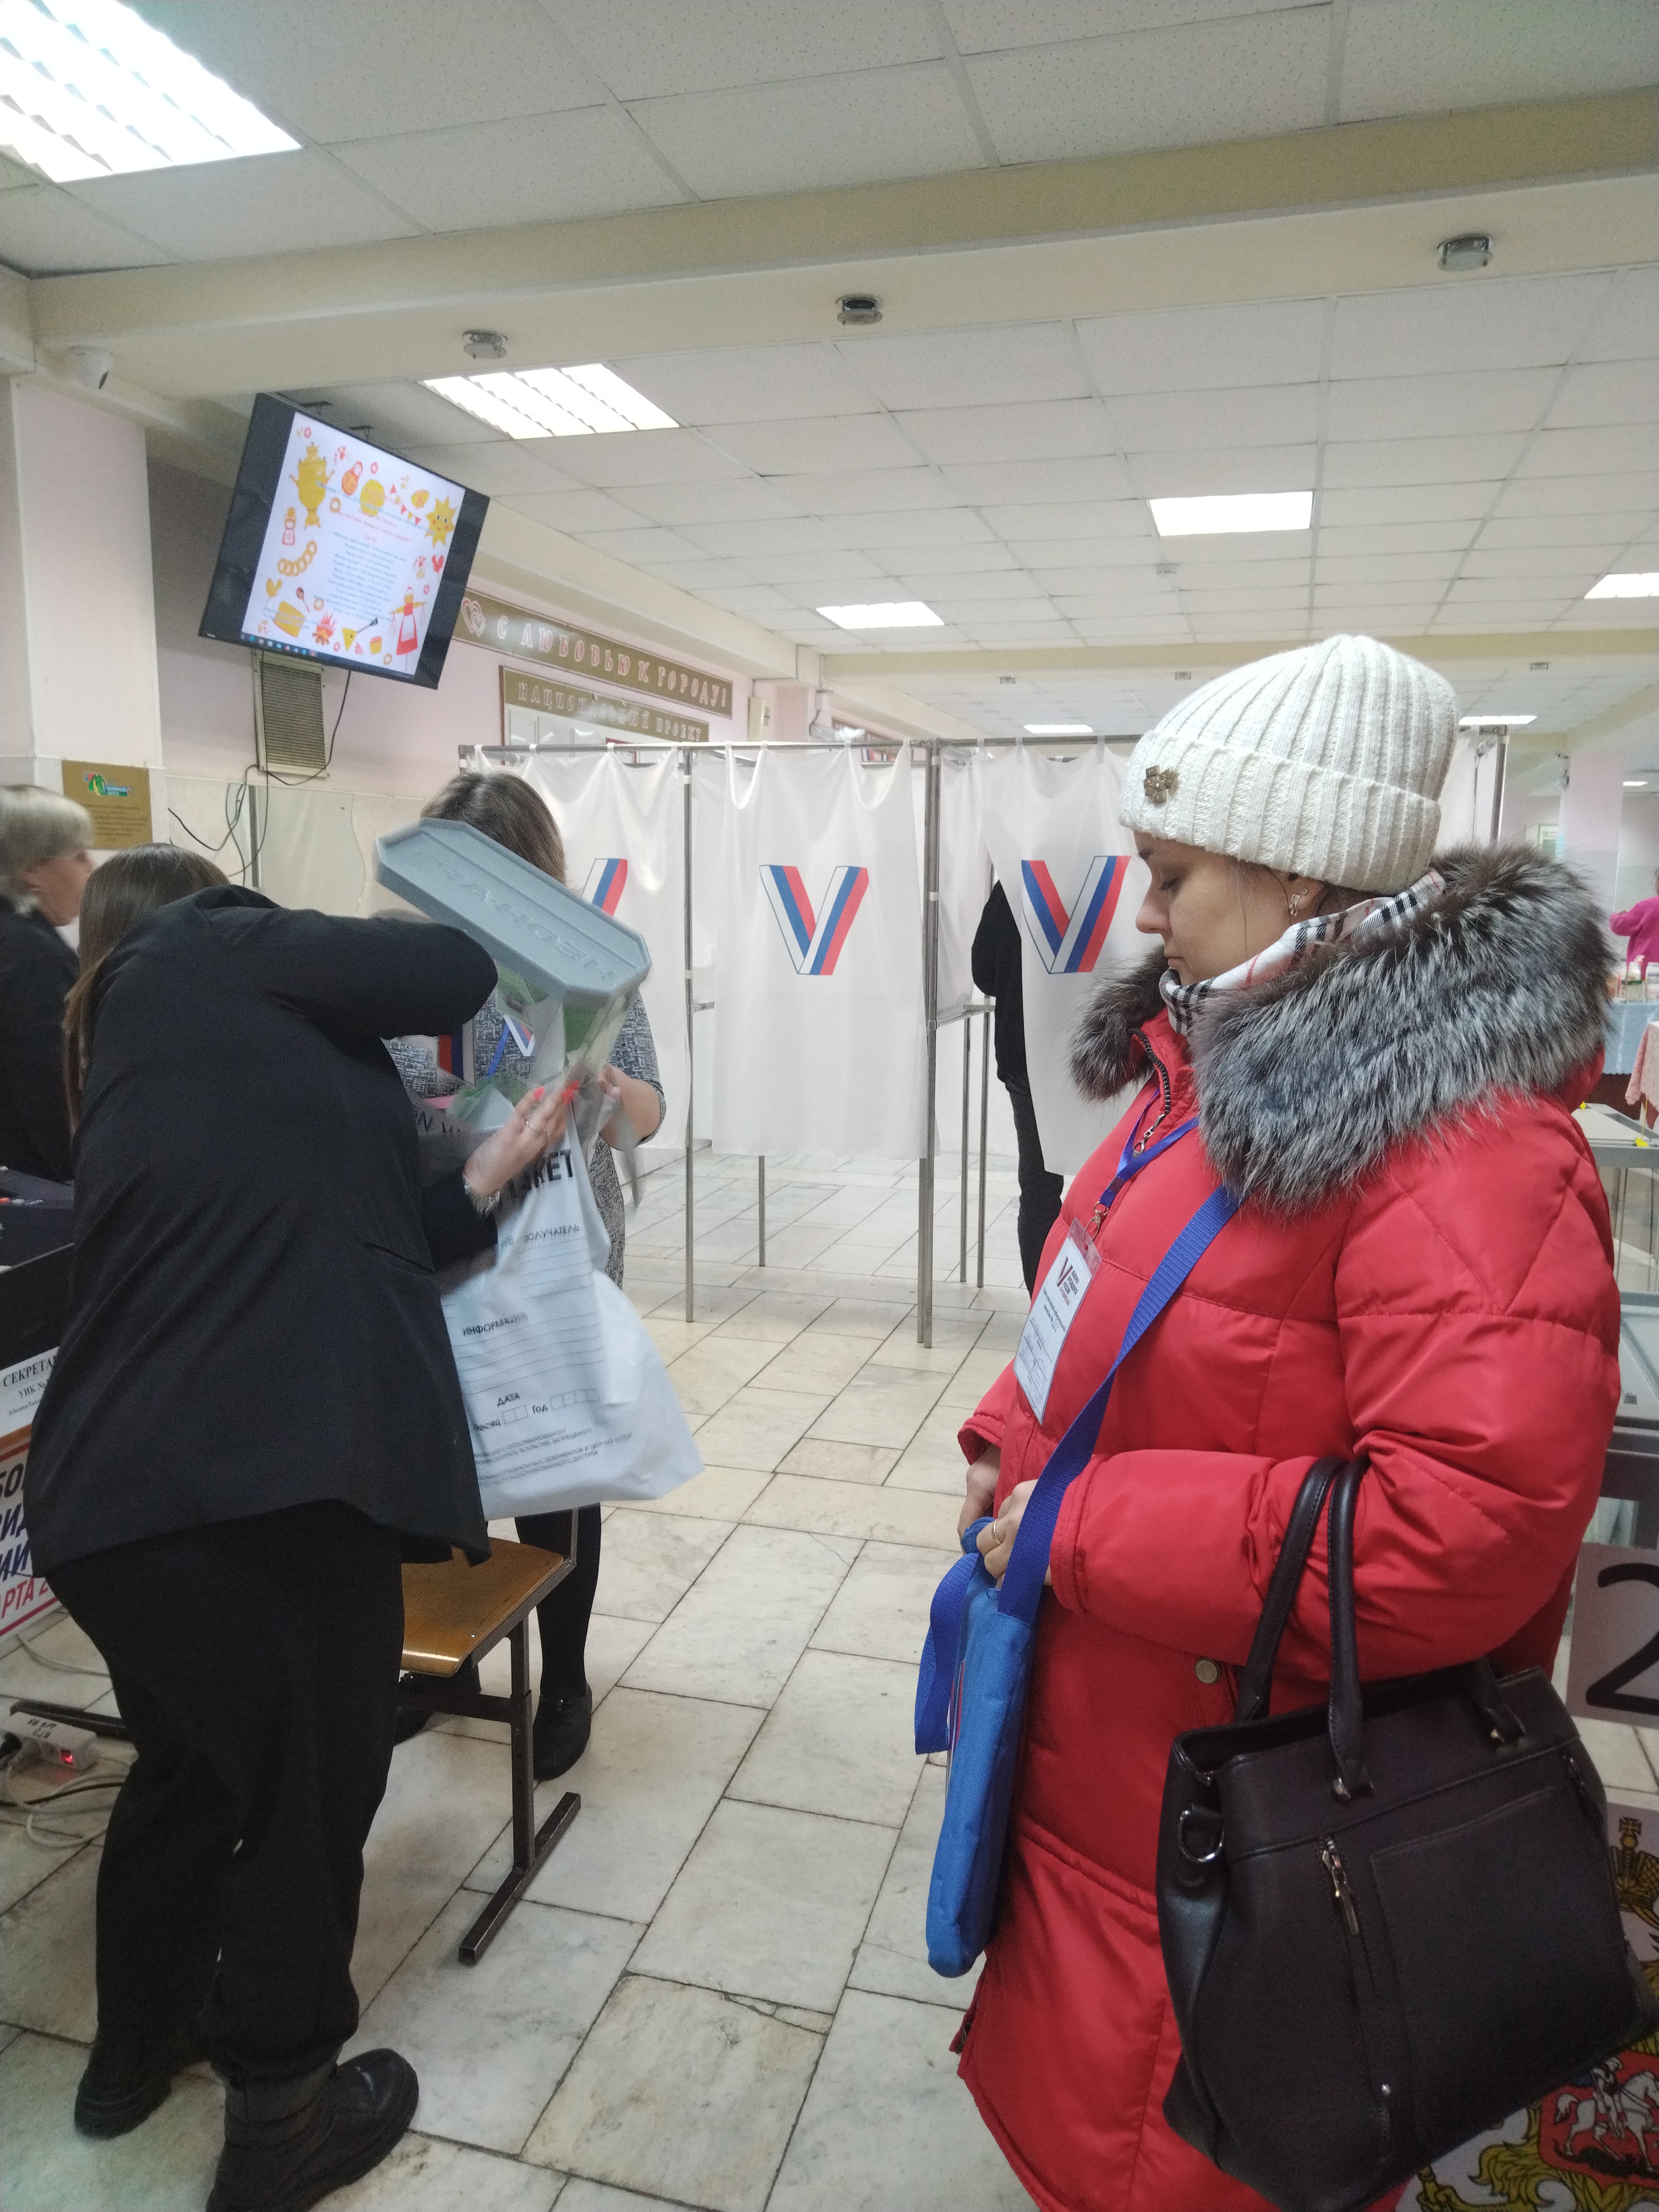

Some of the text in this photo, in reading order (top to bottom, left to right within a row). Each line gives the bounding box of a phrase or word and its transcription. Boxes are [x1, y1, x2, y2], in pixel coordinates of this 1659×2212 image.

[497, 615, 727, 707] С ЛЮБОВЬЮ К ГОРОДУ!
[518, 682, 702, 742] НАЦИОНАЛЬНЫЙ ПРОЕКТ
[524, 1224, 579, 1244] ПОЛУЧАТЕЛЬ
[462, 1311, 528, 1337] ИНФОРМАЦИЯ
[3, 1355, 56, 1387] СЕКРЕТА
[497, 1392, 520, 1407] ДАТА
[0, 1577, 35, 1619] РТА
